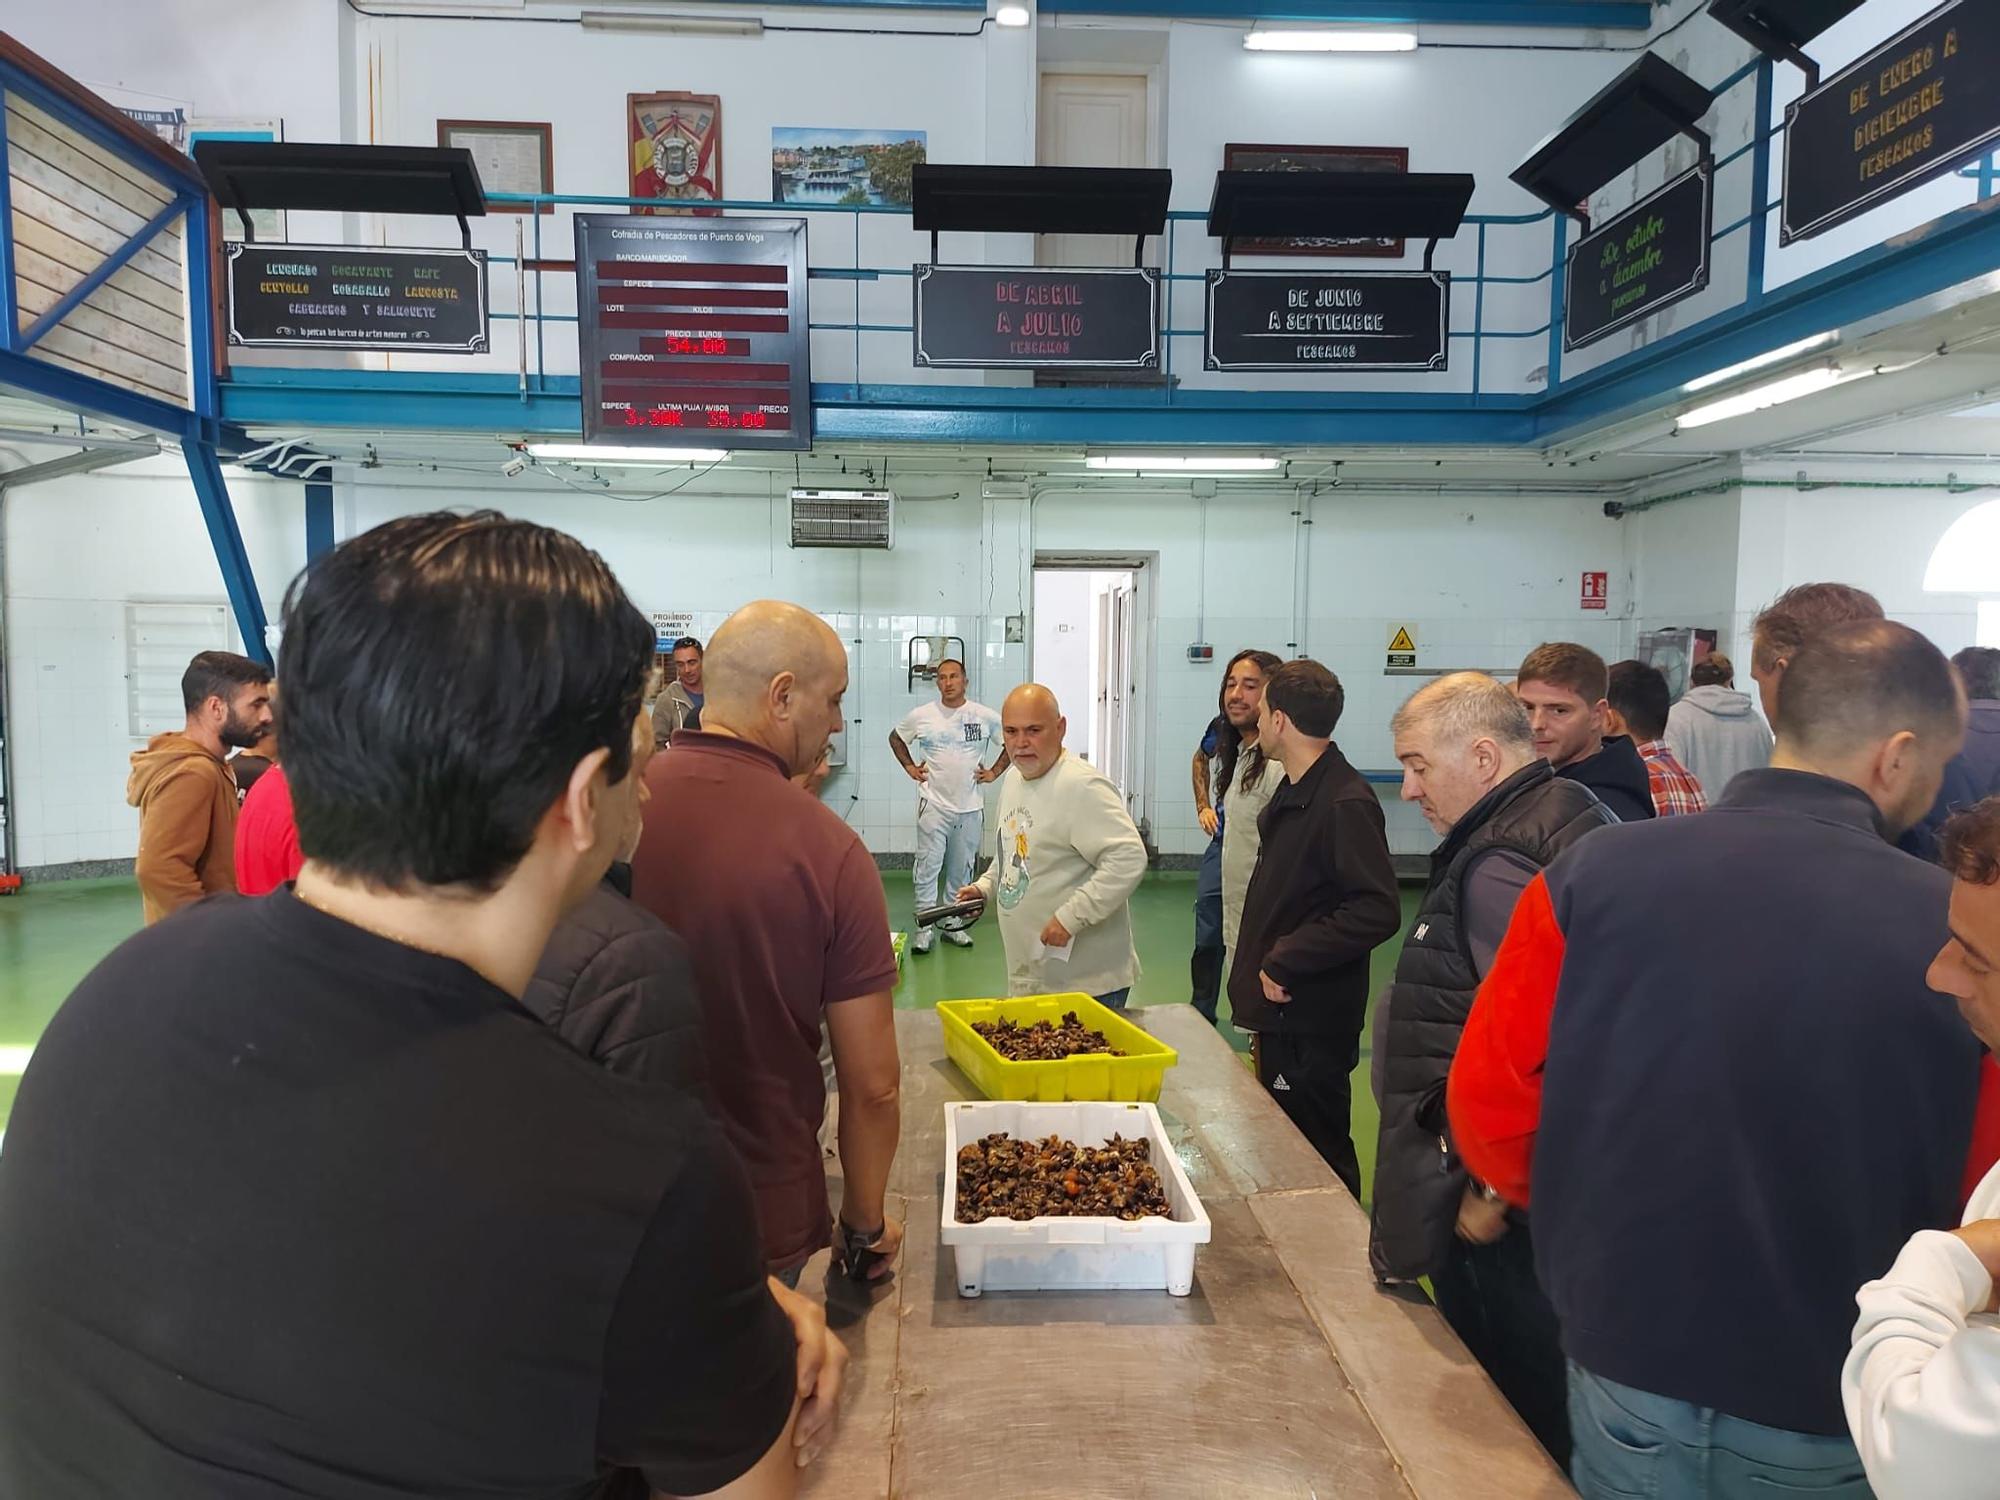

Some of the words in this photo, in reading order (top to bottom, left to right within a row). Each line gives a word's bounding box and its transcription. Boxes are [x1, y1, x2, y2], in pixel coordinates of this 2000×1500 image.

[1850, 79, 1871, 115] DE
[1879, 43, 1934, 97] ENERO
[1944, 28, 1958, 58] A
[1854, 77, 1945, 152] DICIEMBRE
[1859, 123, 1934, 182] PESCAMOS
[644, 230, 654, 240] de
[655, 231, 698, 241] Pescadores
[699, 231, 709, 241] de
[710, 232, 734, 241] Puerto
[735, 233, 745, 242] de
[746, 233, 764, 244] Vega
[624, 280, 653, 288] ESPECIE
[996, 281, 1020, 302] DE
[1024, 284, 1083, 306] ABRIL
[1288, 289, 1310, 308] DE
[1315, 289, 1363, 308] JUNIO
[606, 304, 625, 312] LOTE
[693, 306, 713, 314] KILOS
[996, 311, 1012, 333] A
[1020, 312, 1083, 336] JULIO
[1268, 311, 1281, 330] A
[1286, 312, 1385, 332] SEPTIEMBRE
[609, 353, 654, 361] COMPRADOR
[1296, 345, 1357, 359] PESCAMOS
[602, 402, 631, 410] ESPECIE
[705, 404, 730, 412] AVISOS
[759, 405, 789, 413] PRECIO
